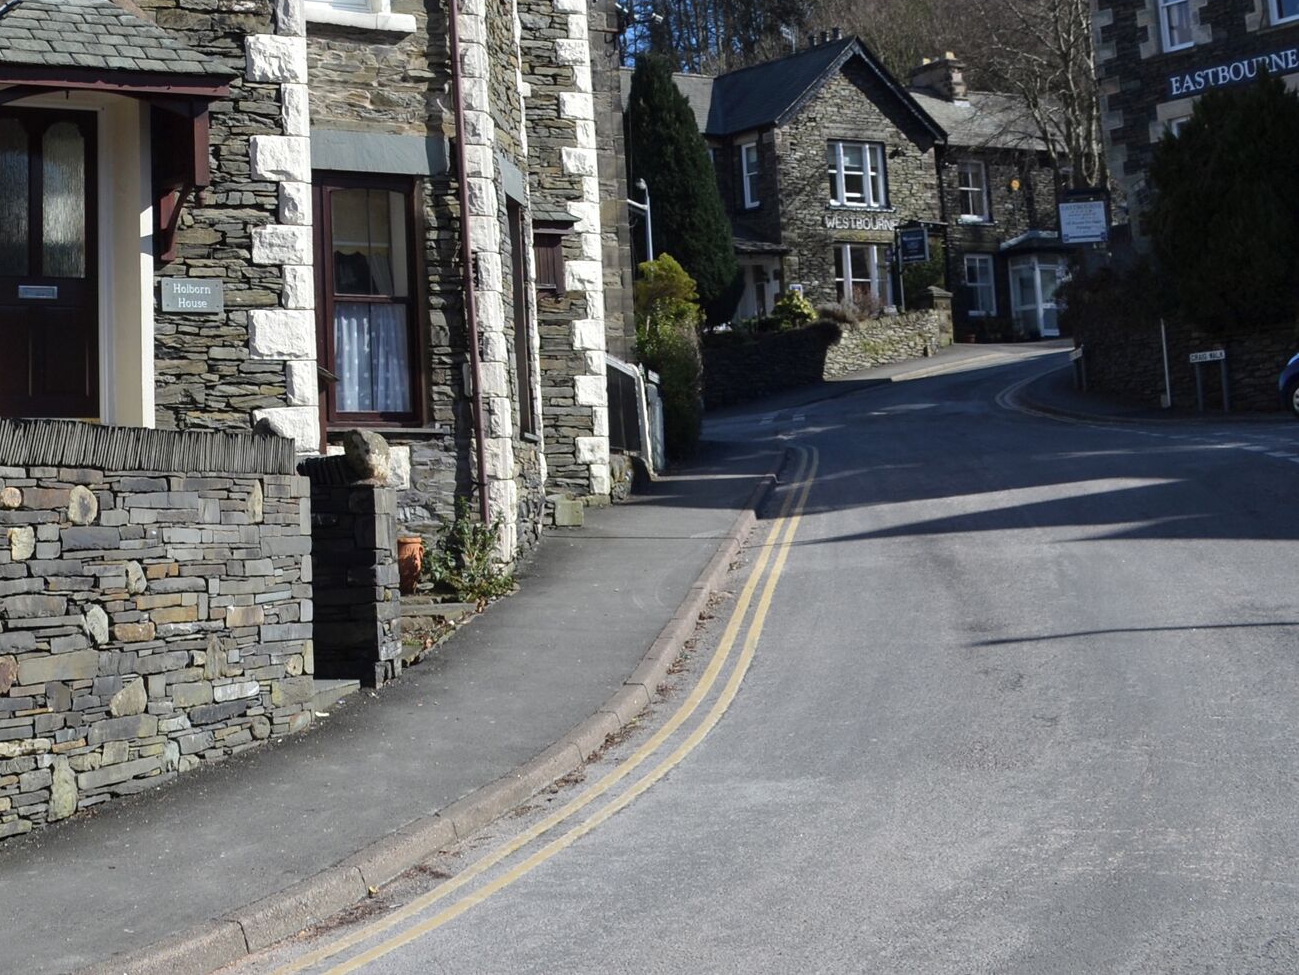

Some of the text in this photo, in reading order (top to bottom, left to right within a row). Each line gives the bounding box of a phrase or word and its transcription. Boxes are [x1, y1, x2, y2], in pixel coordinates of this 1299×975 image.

[1170, 48, 1299, 95] EASTBOURNE
[825, 215, 898, 231] WESTBOURNE
[173, 283, 211, 294] Holborn
[178, 298, 208, 308] House
